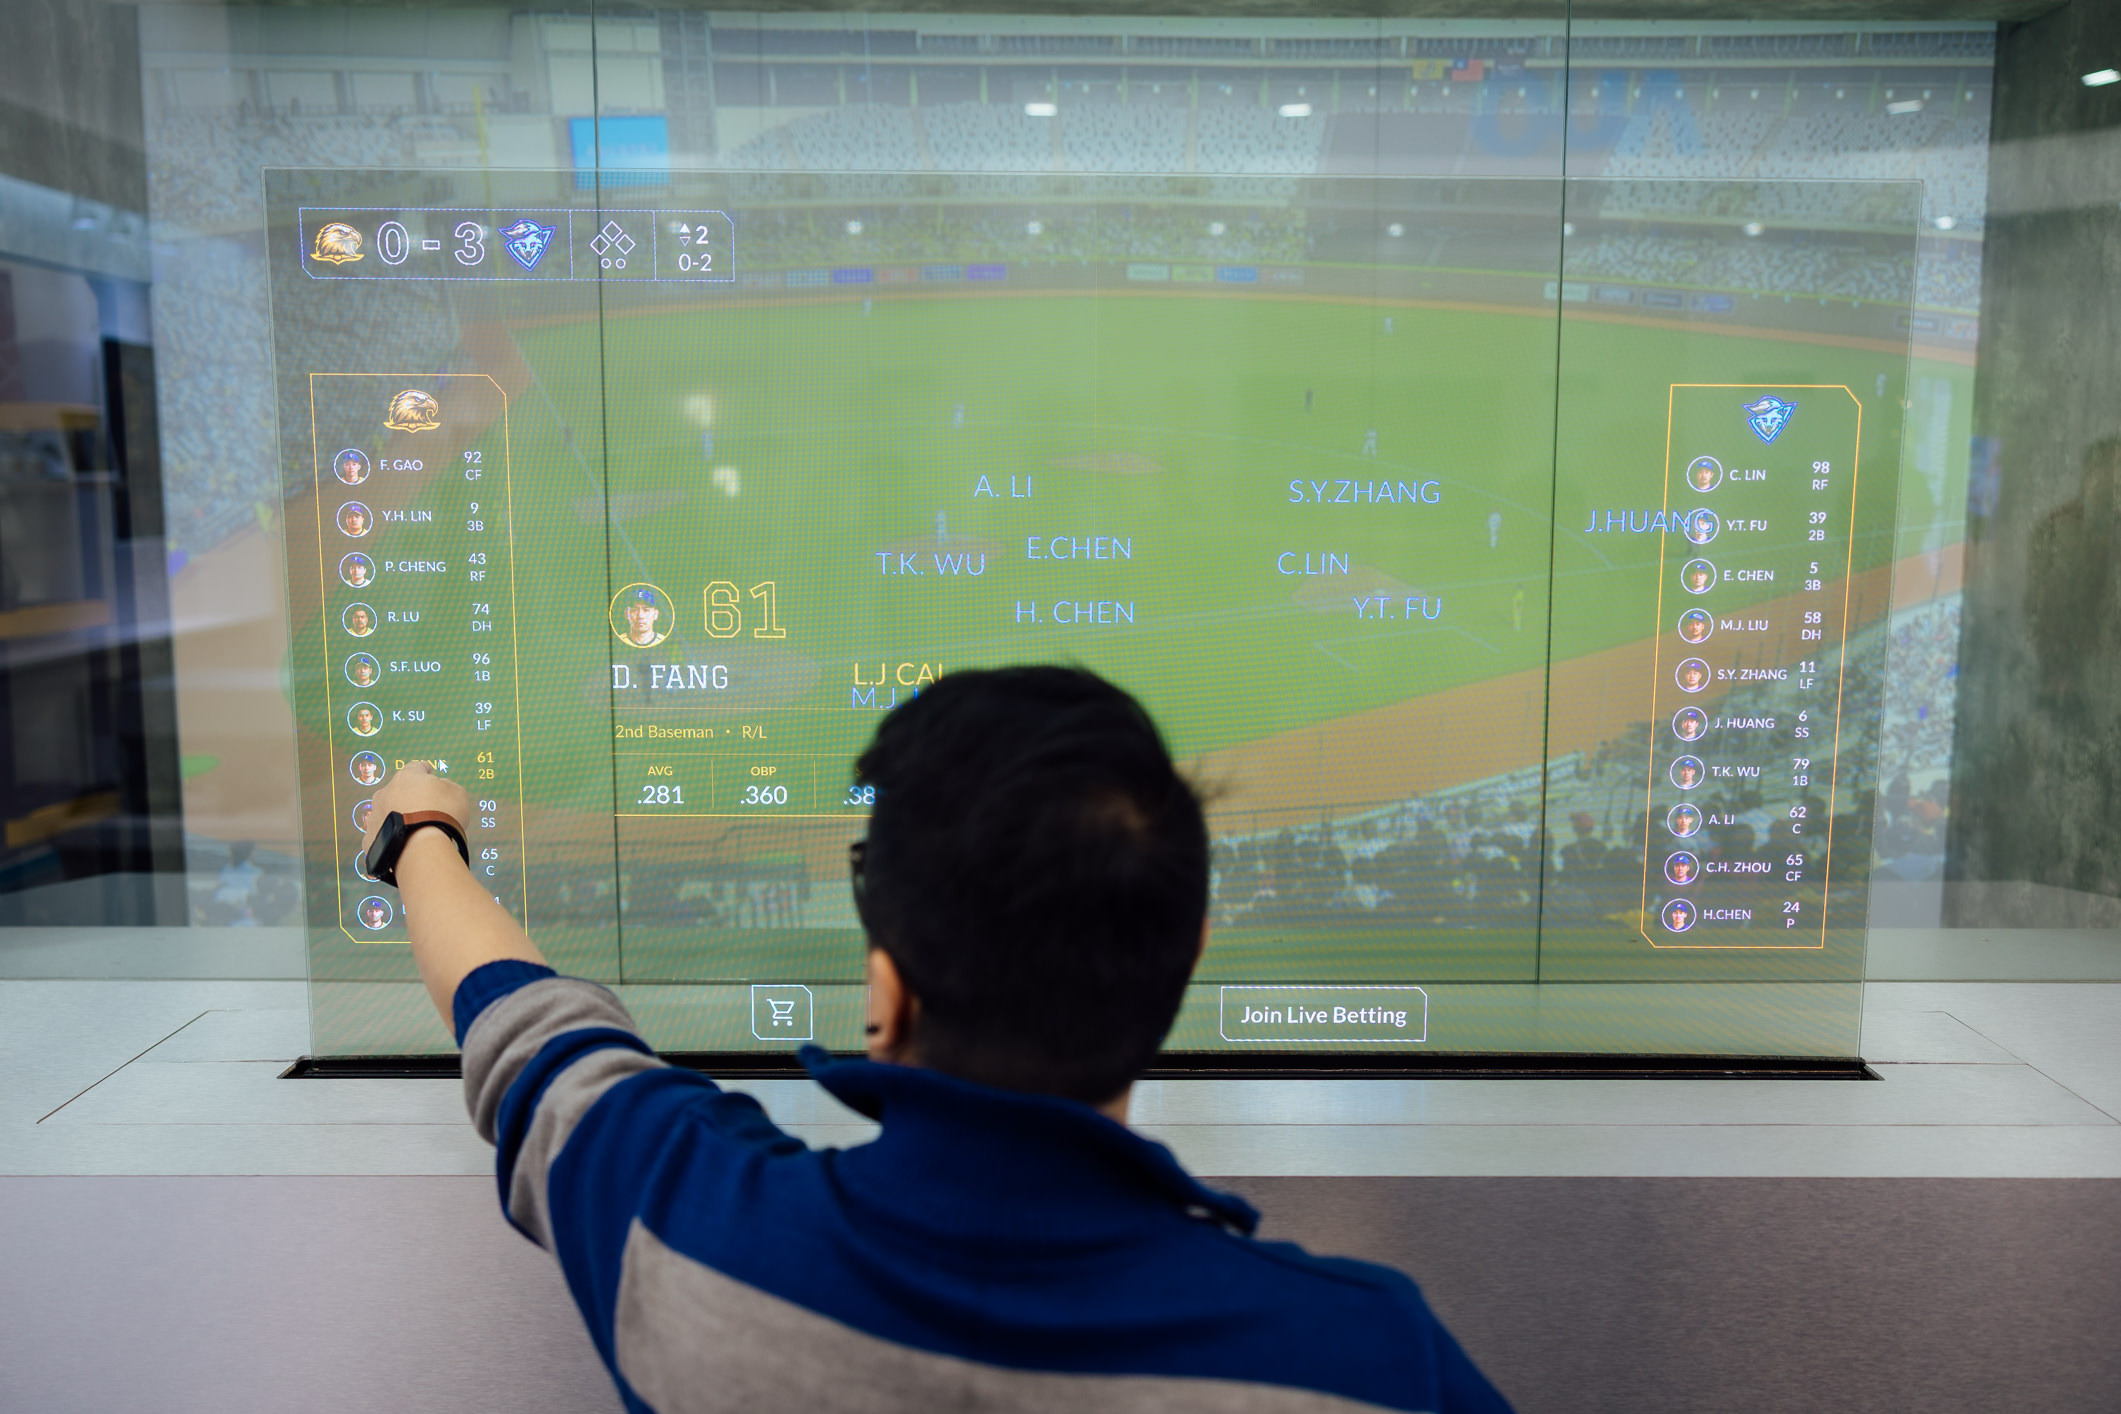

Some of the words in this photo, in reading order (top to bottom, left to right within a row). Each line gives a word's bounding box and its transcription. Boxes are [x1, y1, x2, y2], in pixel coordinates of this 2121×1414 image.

[696, 225, 709, 244] 2
[376, 220, 410, 265] 0
[454, 222, 485, 266] 3
[678, 254, 712, 272] 0-2
[464, 451, 482, 463] 92
[380, 460, 390, 471] F.
[393, 459, 423, 471] GAO
[1812, 461, 1830, 474] 98
[465, 469, 482, 481] CF
[1729, 470, 1742, 481] C.
[1745, 469, 1766, 481] LIN
[974, 474, 1000, 498] A.
[1011, 475, 1031, 498] LI
[1812, 479, 1829, 490] RF
[1288, 479, 1441, 504] S.Y.ZHANG
[470, 502, 479, 514] 9
[382, 510, 408, 522] Y.H.
[411, 510, 432, 522] LIN
[1584, 509, 1715, 533] J.HUANG
[1808, 511, 1827, 524] 39
[467, 520, 484, 531] 3B
[1726, 520, 1747, 531] Y.T.
[1750, 520, 1767, 531] FU
[1808, 530, 1825, 541] 2B
[1026, 536, 1132, 560] E.CHEN
[468, 552, 486, 565] 43
[876, 552, 925, 575] T.K.
[934, 552, 986, 576] WU
[1277, 552, 1349, 575] C.LIN
[385, 561, 396, 572] P.
[399, 561, 447, 573] CHENG
[1810, 562, 1818, 574] 5
[470, 570, 486, 582] RF
[1723, 570, 1734, 582] E.
[1737, 570, 1774, 582] CHEN
[1804, 580, 1821, 591] 3B
[472, 603, 490, 615] 74
[703, 581, 786, 639] 61
[1015, 601, 1043, 623] H.
[1053, 600, 1135, 624] CHEN
[1353, 597, 1395, 620] Y.T.
[1405, 597, 1442, 620] FU
[387, 611, 400, 623] R.
[403, 611, 420, 623] LU
[1804, 611, 1821, 624] 58
[472, 621, 492, 632] DH
[1720, 619, 1745, 631] M.J.
[1748, 619, 1769, 631] LIU
[1801, 629, 1821, 640] DH
[472, 652, 490, 665] 96
[389, 661, 411, 673] S.F.
[413, 661, 441, 673] LUO
[1800, 661, 1816, 673] 11
[474, 670, 491, 682] 1B
[611, 664, 638, 689] D.
[650, 664, 729, 689] FANG
[854, 662, 886, 685] L.J
[896, 662, 943, 686] CAI
[1717, 669, 1738, 680] S.Y.
[1740, 669, 1788, 680] ZHANG
[1799, 678, 1814, 689] LF
[474, 702, 492, 714] 39
[392, 710, 405, 722] K.
[408, 710, 425, 722] SU
[1798, 710, 1808, 722] 6
[477, 720, 492, 731] LF
[1714, 718, 1724, 729] J.
[1726, 717, 1775, 729] HUANG
[615, 724, 643, 739] 2nd
[648, 725, 714, 739] Baseman
[742, 725, 767, 740] R/L
[1794, 727, 1809, 738] SS
[477, 751, 495, 763] 61
[1792, 758, 1810, 770] 79
[478, 768, 495, 779] 2B
[647, 765, 673, 776] AVG
[750, 765, 777, 776] OBP
[1711, 766, 1734, 777] T.K.
[1737, 766, 1760, 777] WU
[1792, 775, 1809, 786] 1B
[637, 785, 685, 805] .281
[740, 785, 788, 805] .360
[843, 785, 876, 805] .38
[479, 800, 496, 812] 90
[1789, 806, 1807, 818] 62
[480, 817, 496, 828] SS
[1708, 814, 1721, 825] A.
[1724, 814, 1735, 825] LI
[1792, 823, 1801, 834] C
[480, 848, 498, 860] 65
[1785, 854, 1803, 866] 65
[485, 865, 495, 876] C
[1705, 862, 1730, 873] C.H.
[1733, 862, 1772, 873] ZHOU
[1785, 871, 1802, 881] CF
[1782, 901, 1800, 913] 24
[1703, 909, 1752, 920] H.CHEN
[1786, 918, 1795, 929] P
[1241, 1006, 1282, 1024] Join
[1287, 1006, 1328, 1024] Live
[1333, 1006, 1407, 1028] Betting
